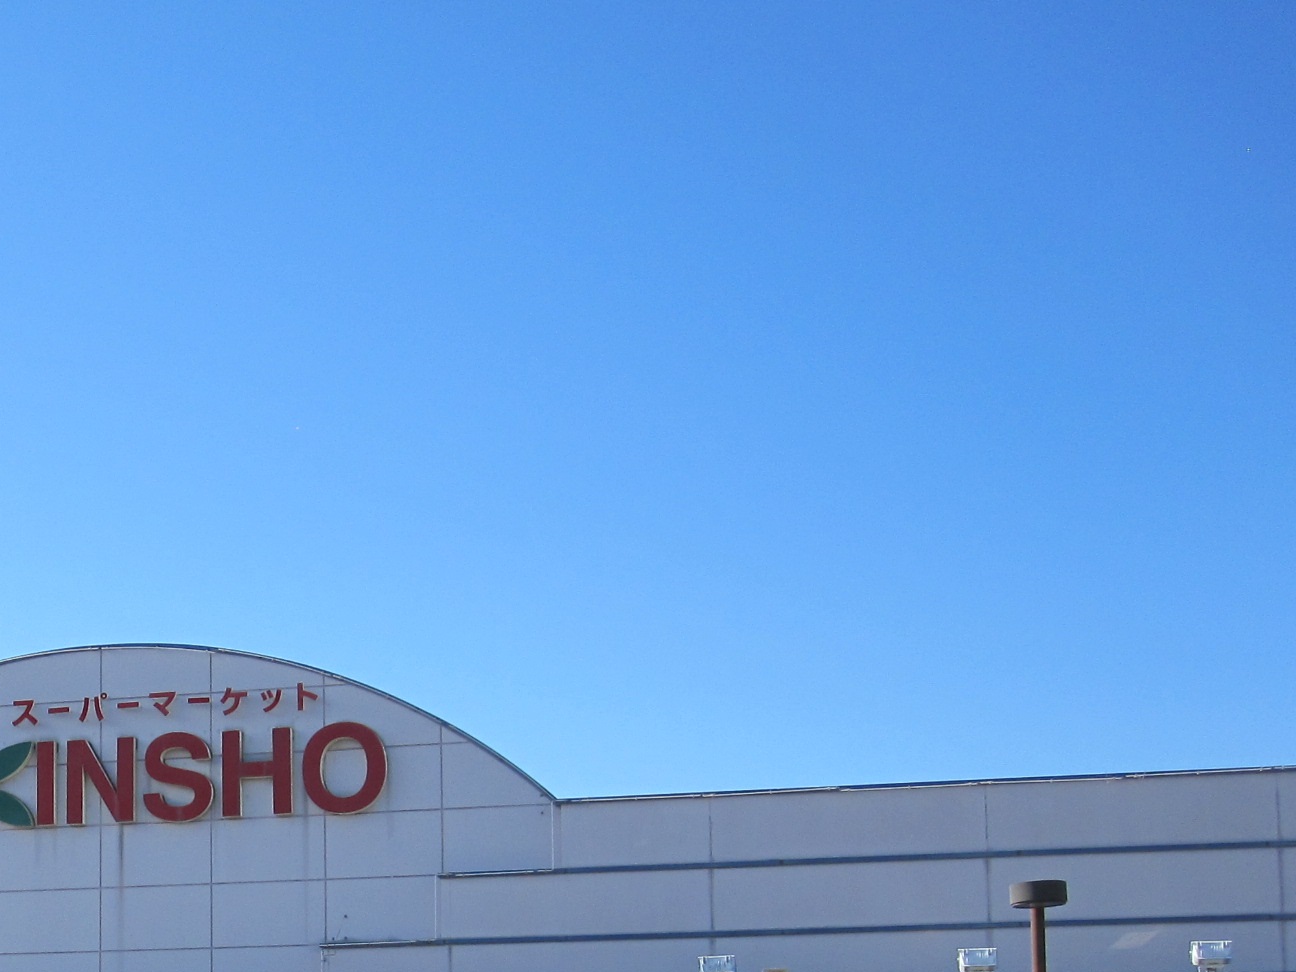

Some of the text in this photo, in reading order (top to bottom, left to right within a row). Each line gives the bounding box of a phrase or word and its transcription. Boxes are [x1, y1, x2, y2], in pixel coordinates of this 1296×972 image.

[12, 682, 319, 727] スーパーマーケット
